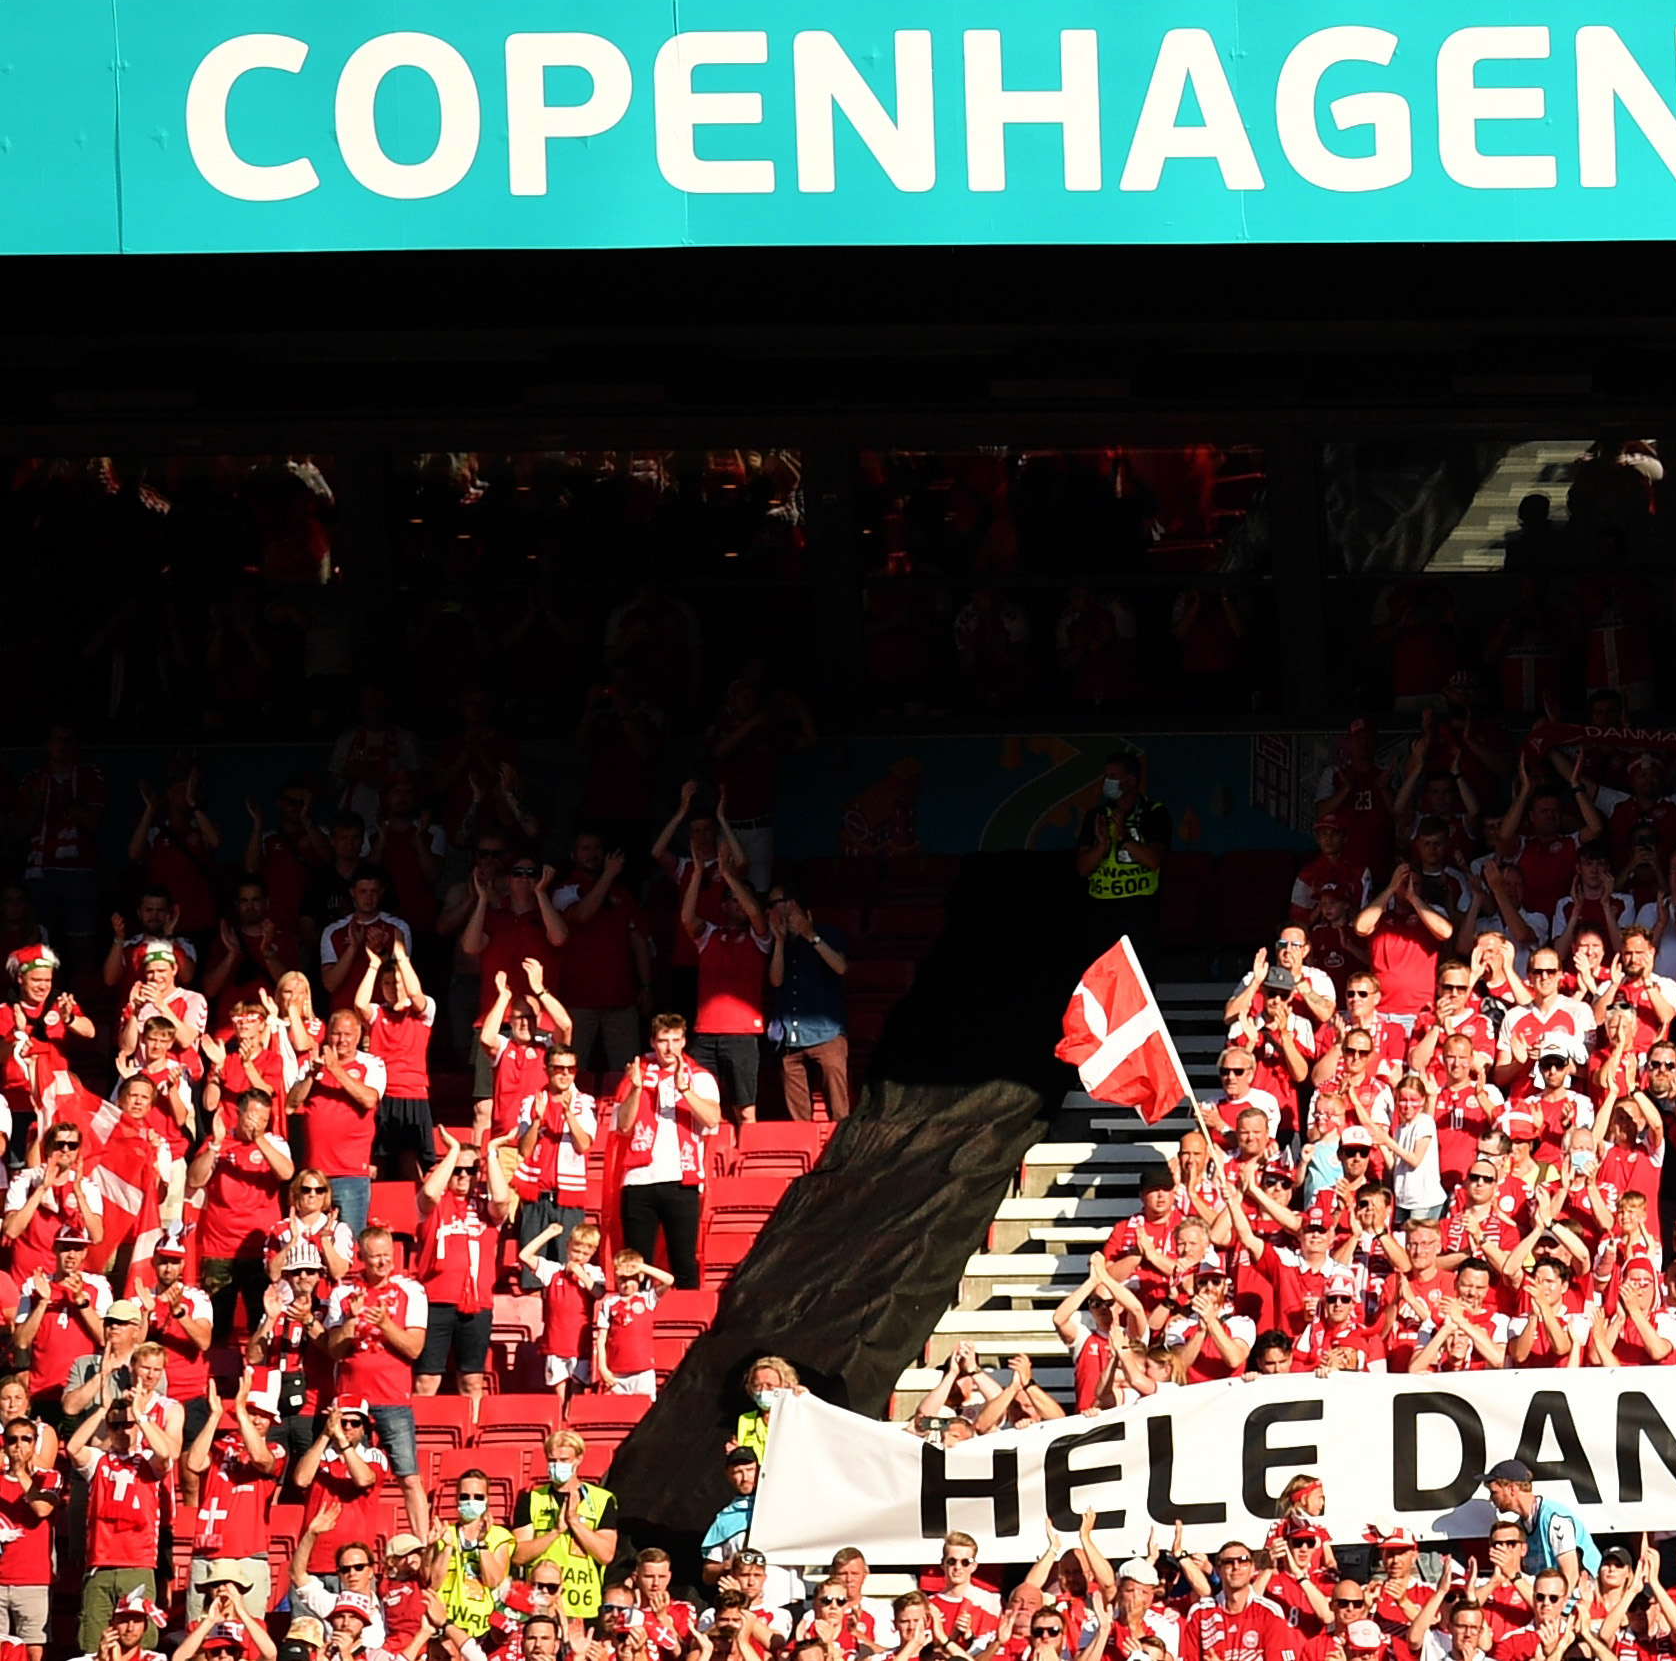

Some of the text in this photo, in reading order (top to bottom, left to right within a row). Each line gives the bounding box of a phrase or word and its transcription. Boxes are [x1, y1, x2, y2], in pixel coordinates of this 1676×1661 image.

[1355, 790, 1371, 811] 23
[1450, 1108, 1464, 1130] 10
[921, 1400, 1323, 1538] HELE
